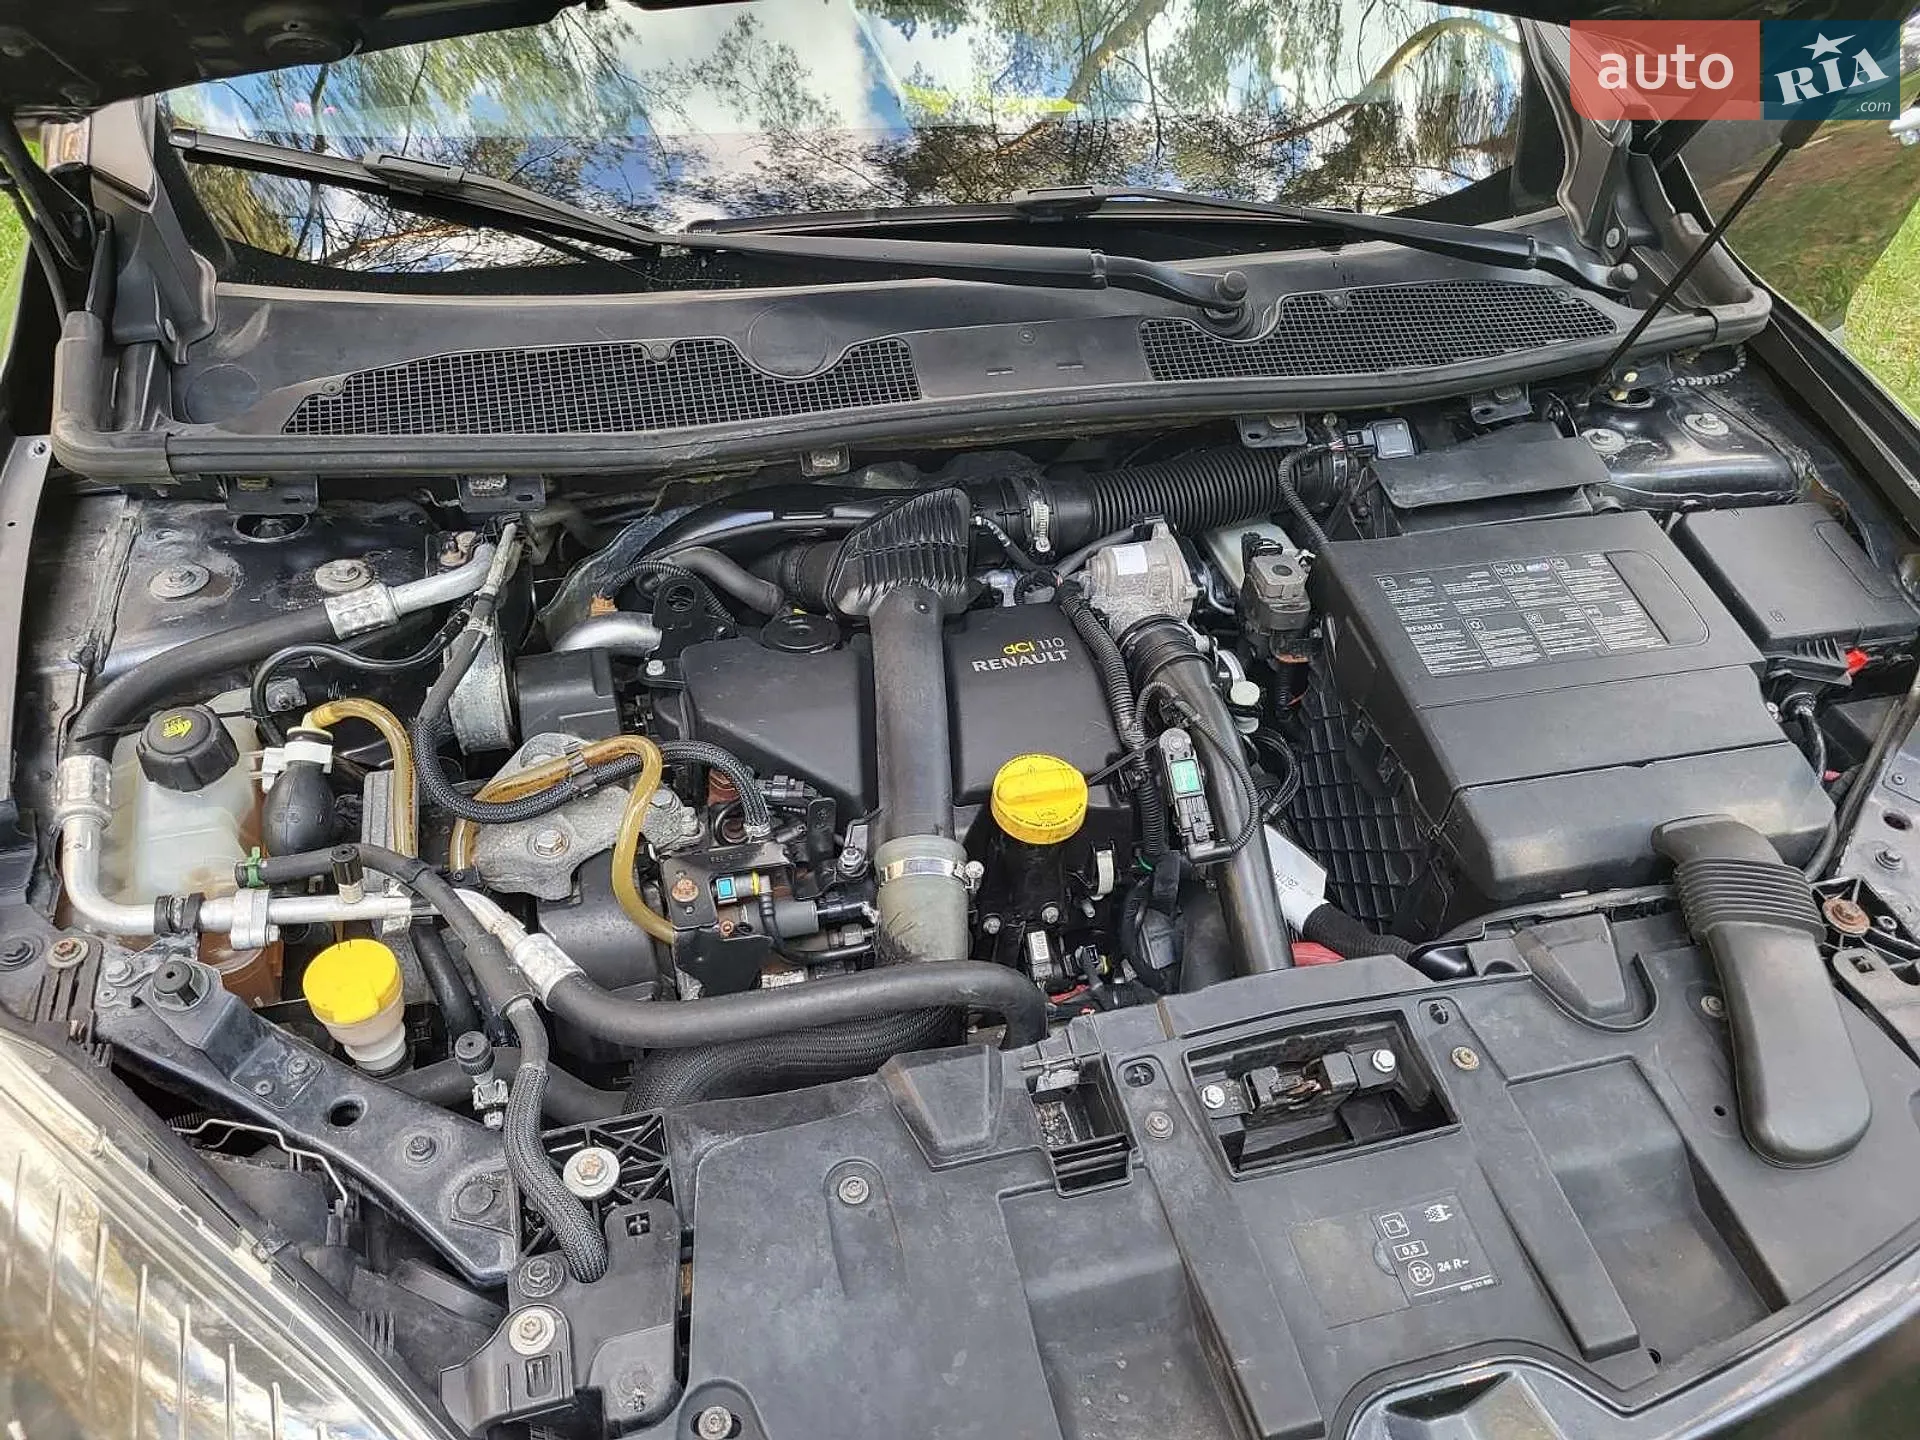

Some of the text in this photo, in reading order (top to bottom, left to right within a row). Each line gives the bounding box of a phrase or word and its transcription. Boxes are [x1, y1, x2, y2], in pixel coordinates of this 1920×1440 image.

[1037, 637, 1065, 650] 110
[971, 649, 1069, 672] RENAULT
[1401, 1244, 1420, 1256] 0,5
